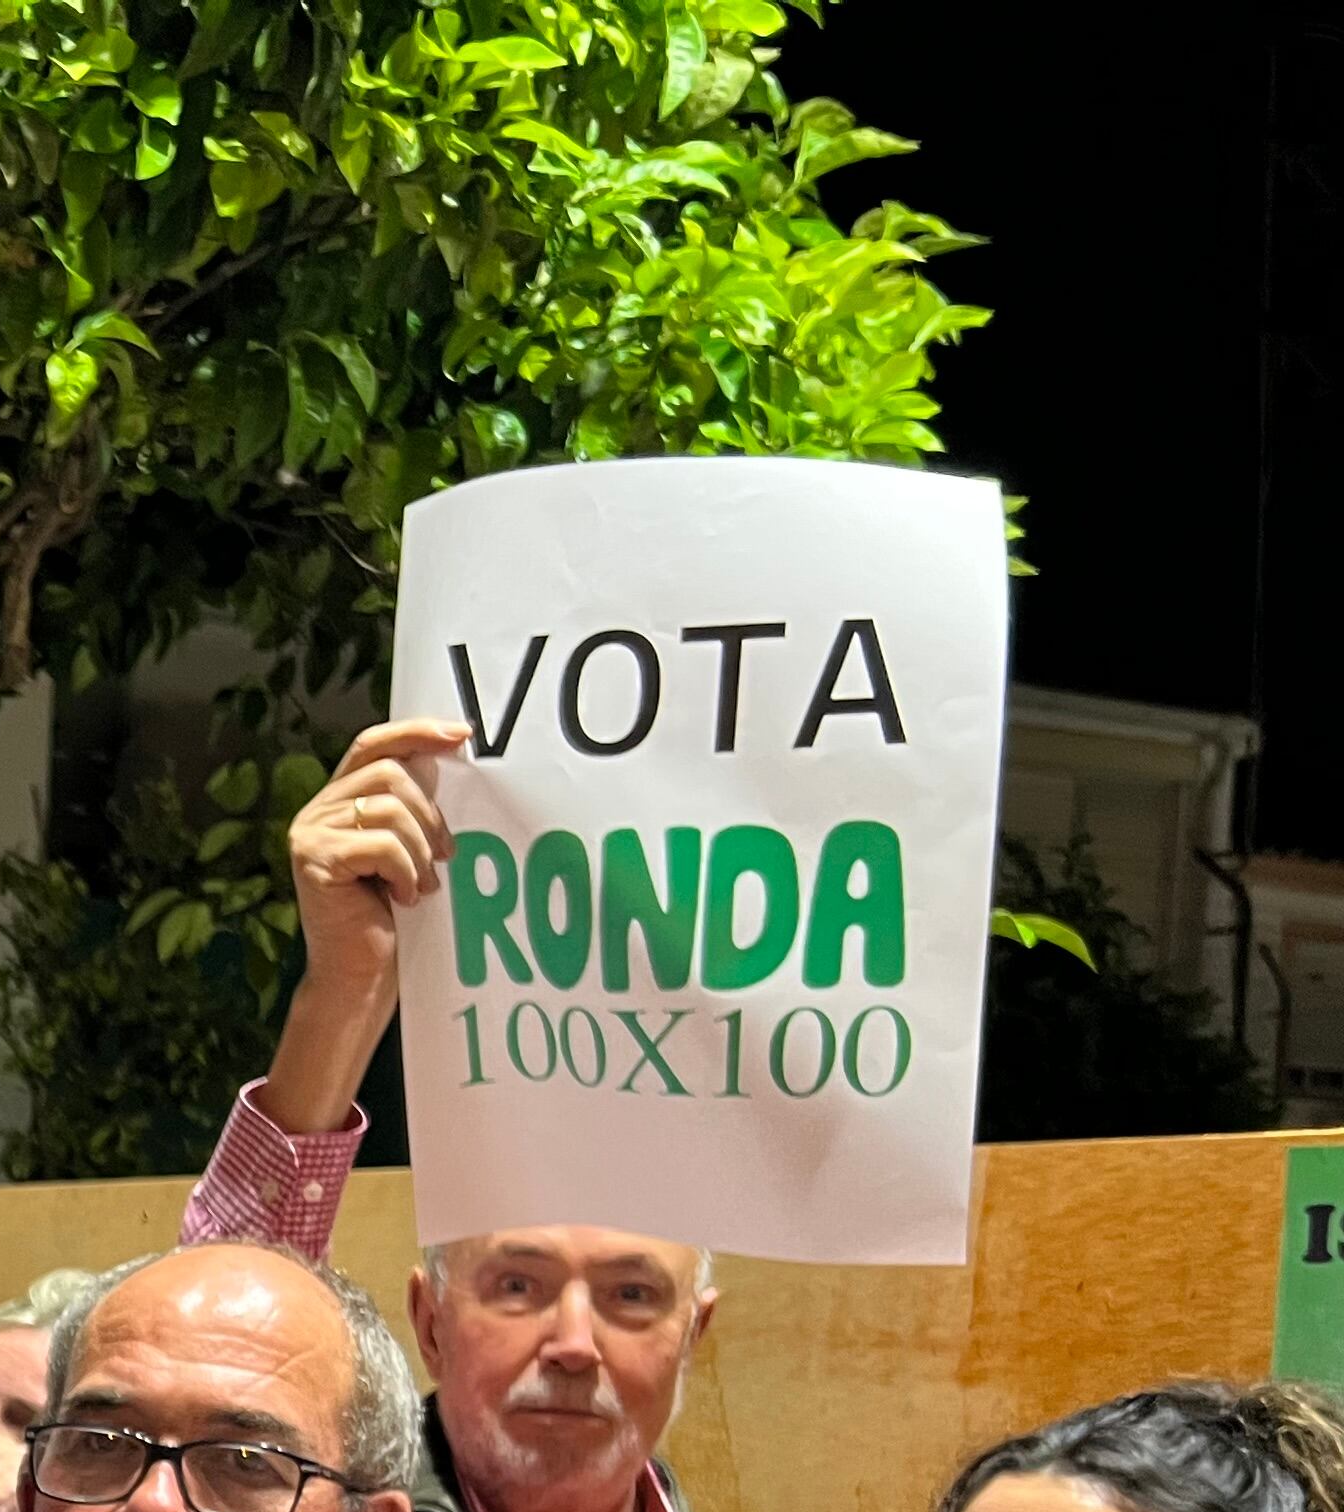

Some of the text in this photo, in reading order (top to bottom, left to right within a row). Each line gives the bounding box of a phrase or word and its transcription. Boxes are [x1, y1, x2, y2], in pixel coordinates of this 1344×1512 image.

[447, 617, 909, 759] VOTA
[449, 820, 907, 992] RONDA
[453, 1001, 914, 1098] 100X100
